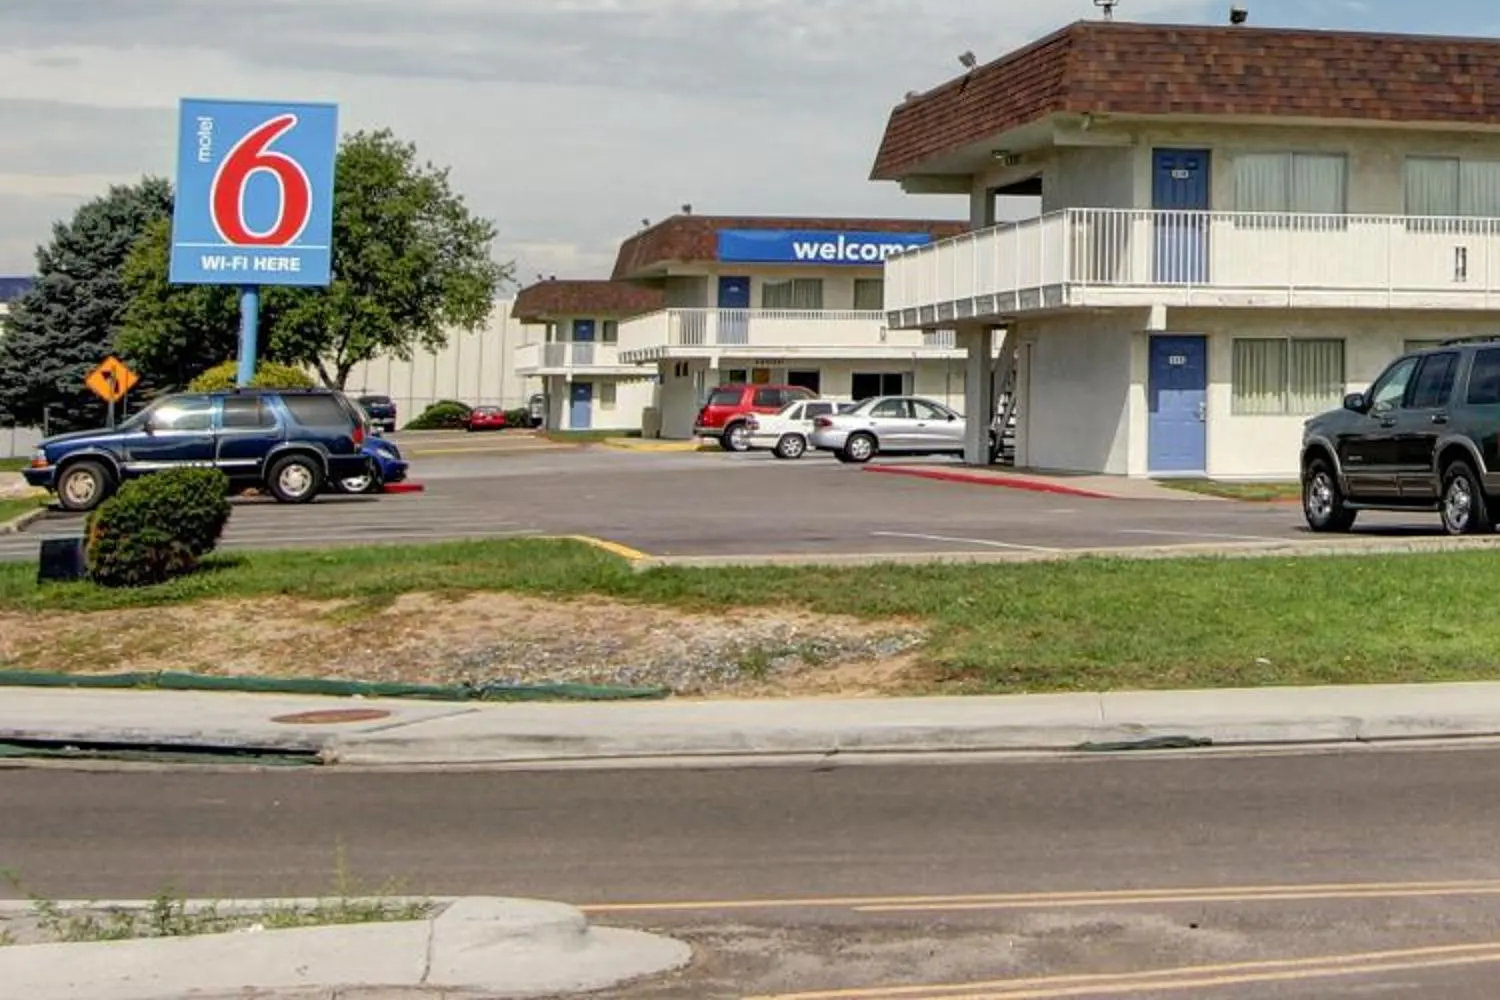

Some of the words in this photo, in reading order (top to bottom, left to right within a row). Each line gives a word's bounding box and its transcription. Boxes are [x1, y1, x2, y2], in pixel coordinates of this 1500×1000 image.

[197, 116, 214, 163] motel
[210, 113, 312, 246] 6
[201, 255, 248, 271] WI-FI
[253, 256, 301, 273] HERE
